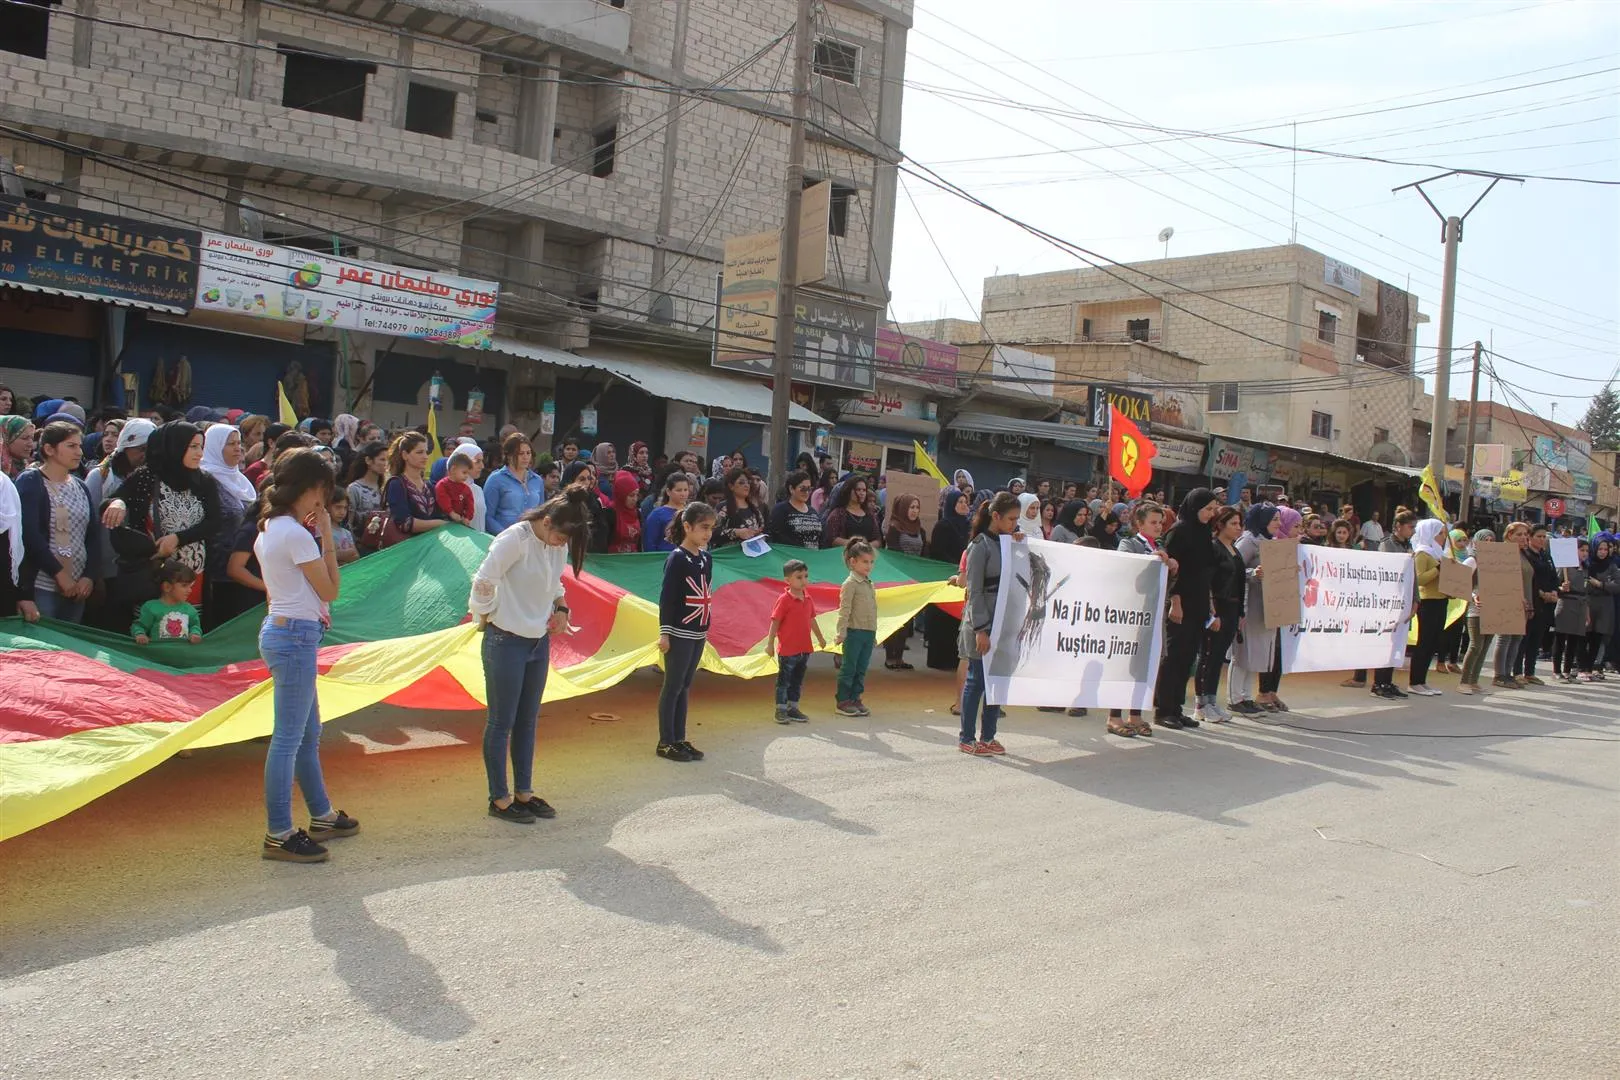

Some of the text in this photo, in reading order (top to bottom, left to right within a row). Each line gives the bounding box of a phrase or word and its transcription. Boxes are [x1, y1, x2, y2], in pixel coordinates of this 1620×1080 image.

[336, 266, 373, 285] عمر
[381, 270, 450, 297] سليمان
[1326, 561, 1338, 578] Na
[1339, 564, 1345, 583] ji
[1346, 562, 1378, 584] kuştina
[1051, 599, 1152, 626] Na ji bo tawana
[1323, 590, 1336, 606] Na
[1336, 592, 1345, 611] ji
[1372, 592, 1378, 609] li
[1056, 632, 1139, 659] kuştina jinan
